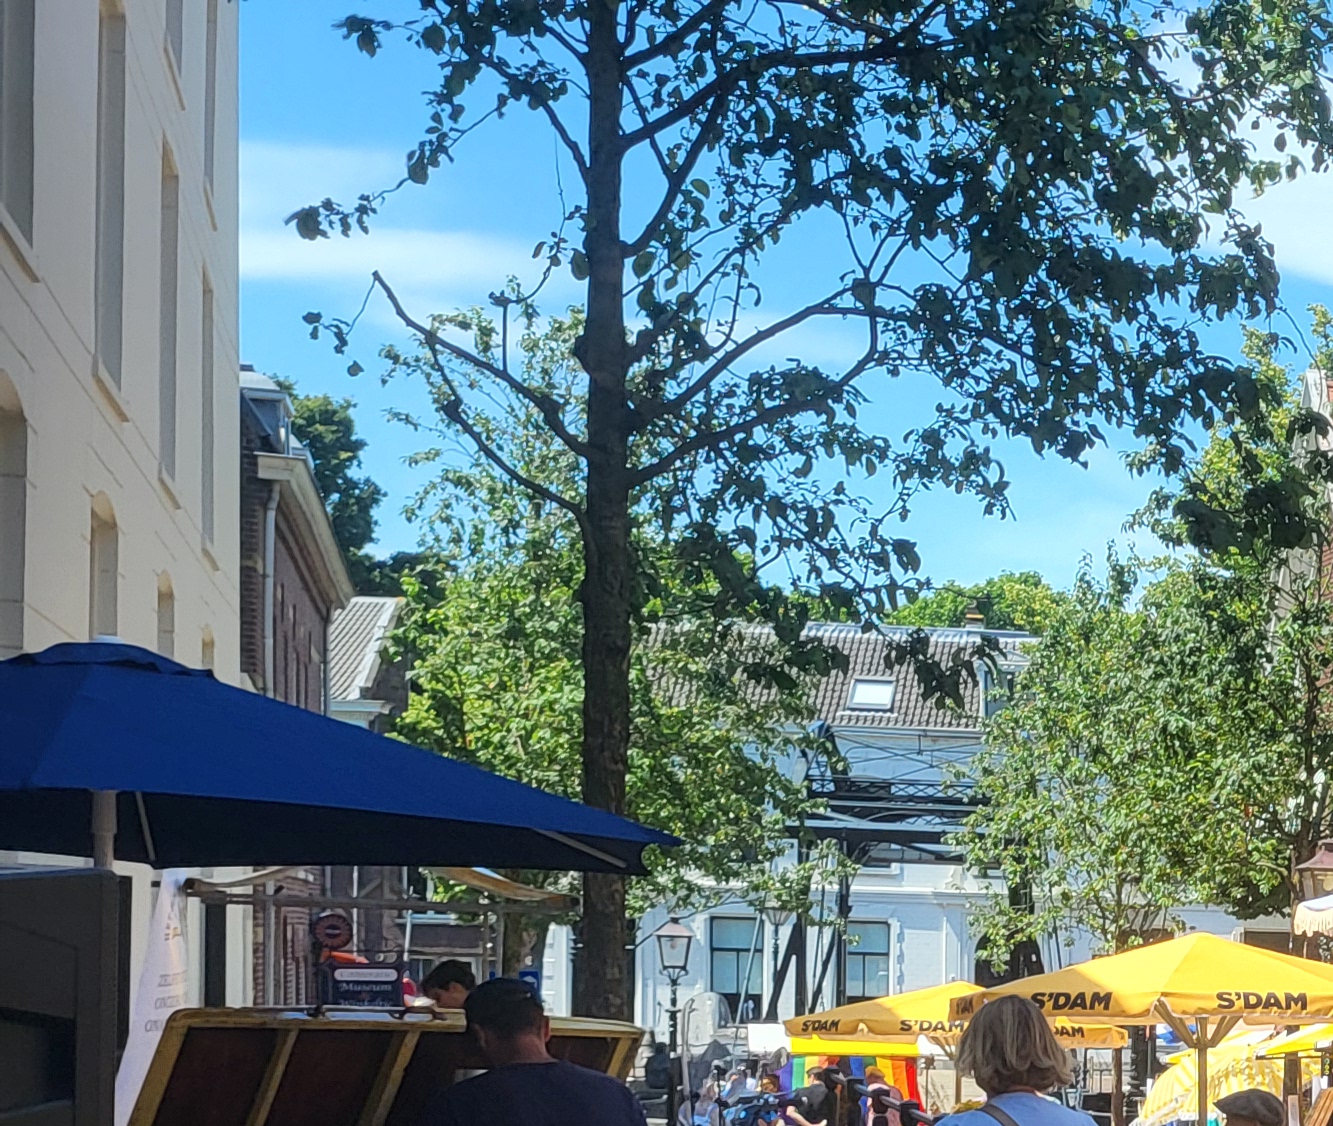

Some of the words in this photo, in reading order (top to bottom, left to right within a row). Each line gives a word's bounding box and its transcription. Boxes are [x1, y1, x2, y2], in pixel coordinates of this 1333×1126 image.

[1030, 991, 1113, 1012] S'DAM
[1216, 992, 1308, 1011] S'DAM
[801, 1018, 841, 1033] S'DAM
[899, 1019, 965, 1033] S'DAM
[1053, 1025, 1085, 1038] DAM
